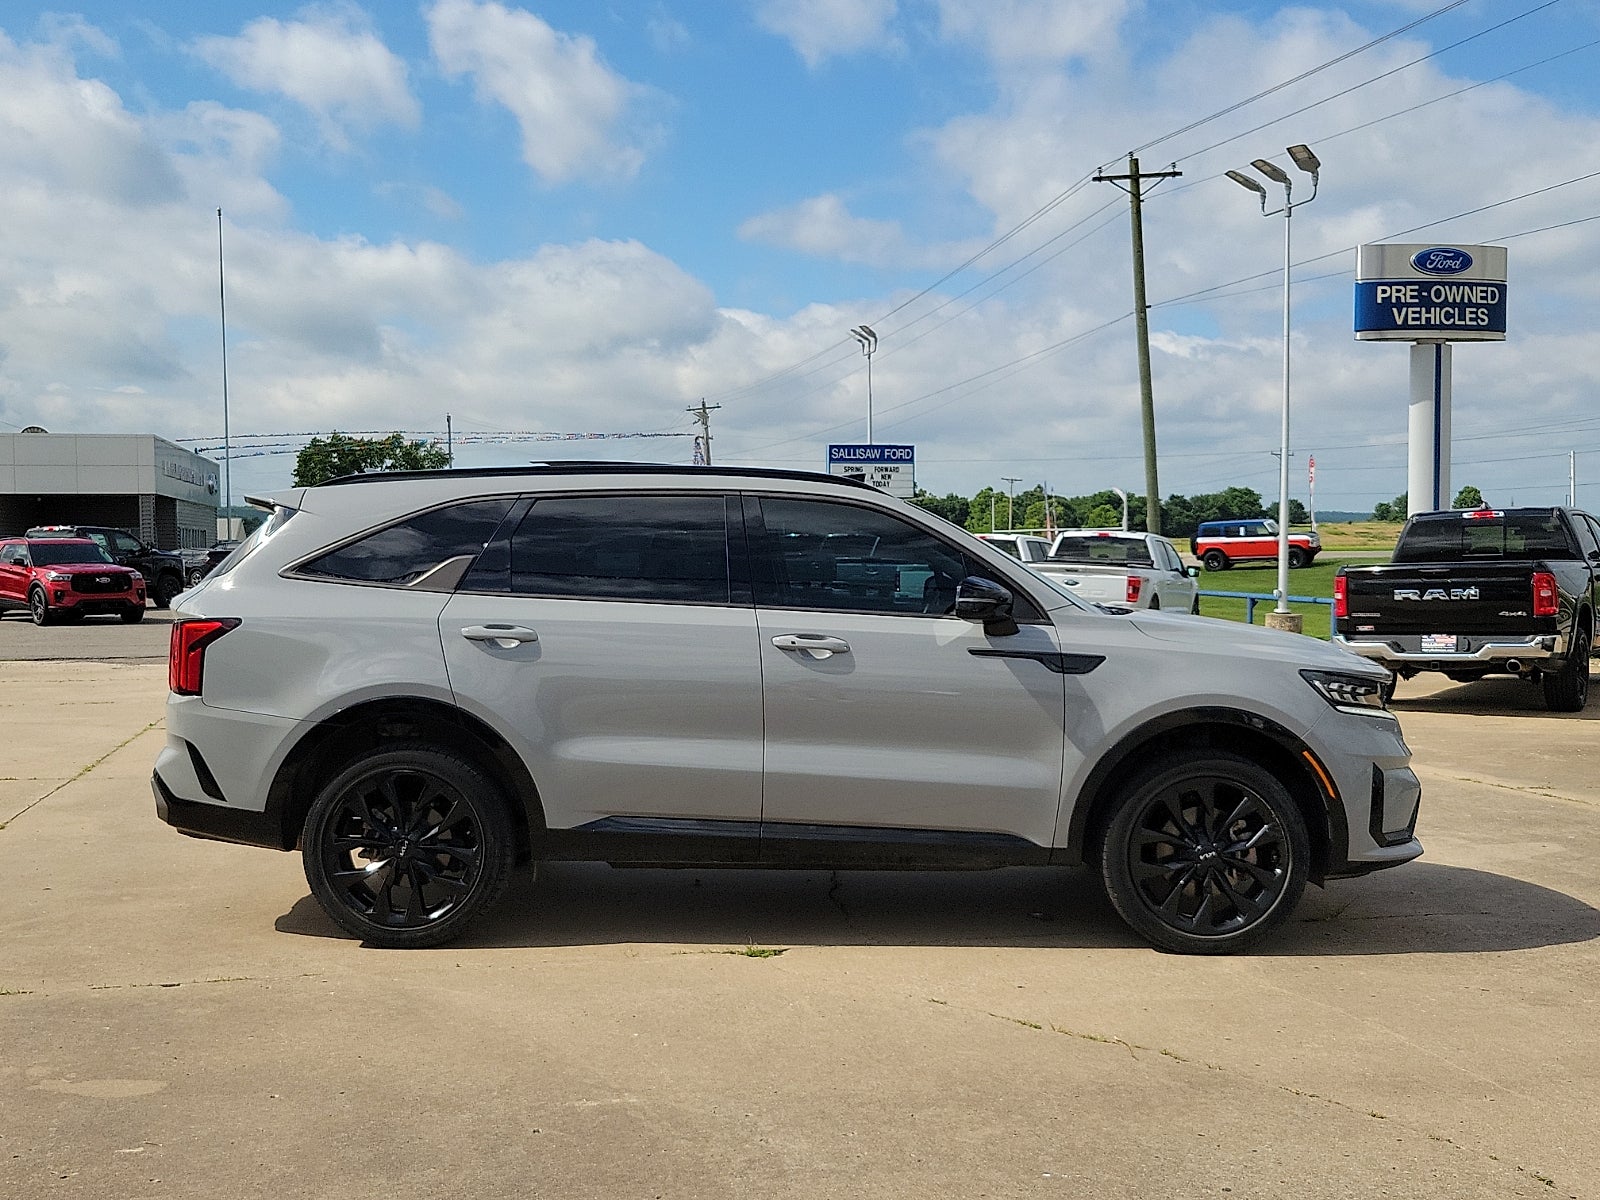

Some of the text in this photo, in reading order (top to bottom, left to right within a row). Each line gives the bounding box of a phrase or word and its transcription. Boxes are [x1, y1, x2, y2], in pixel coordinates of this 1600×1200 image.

[1426, 251, 1463, 269] Ford
[1391, 307, 1489, 326] VEHICLES
[831, 448, 913, 459] SALLISAW FORD
[1393, 588, 1480, 601] RAM
